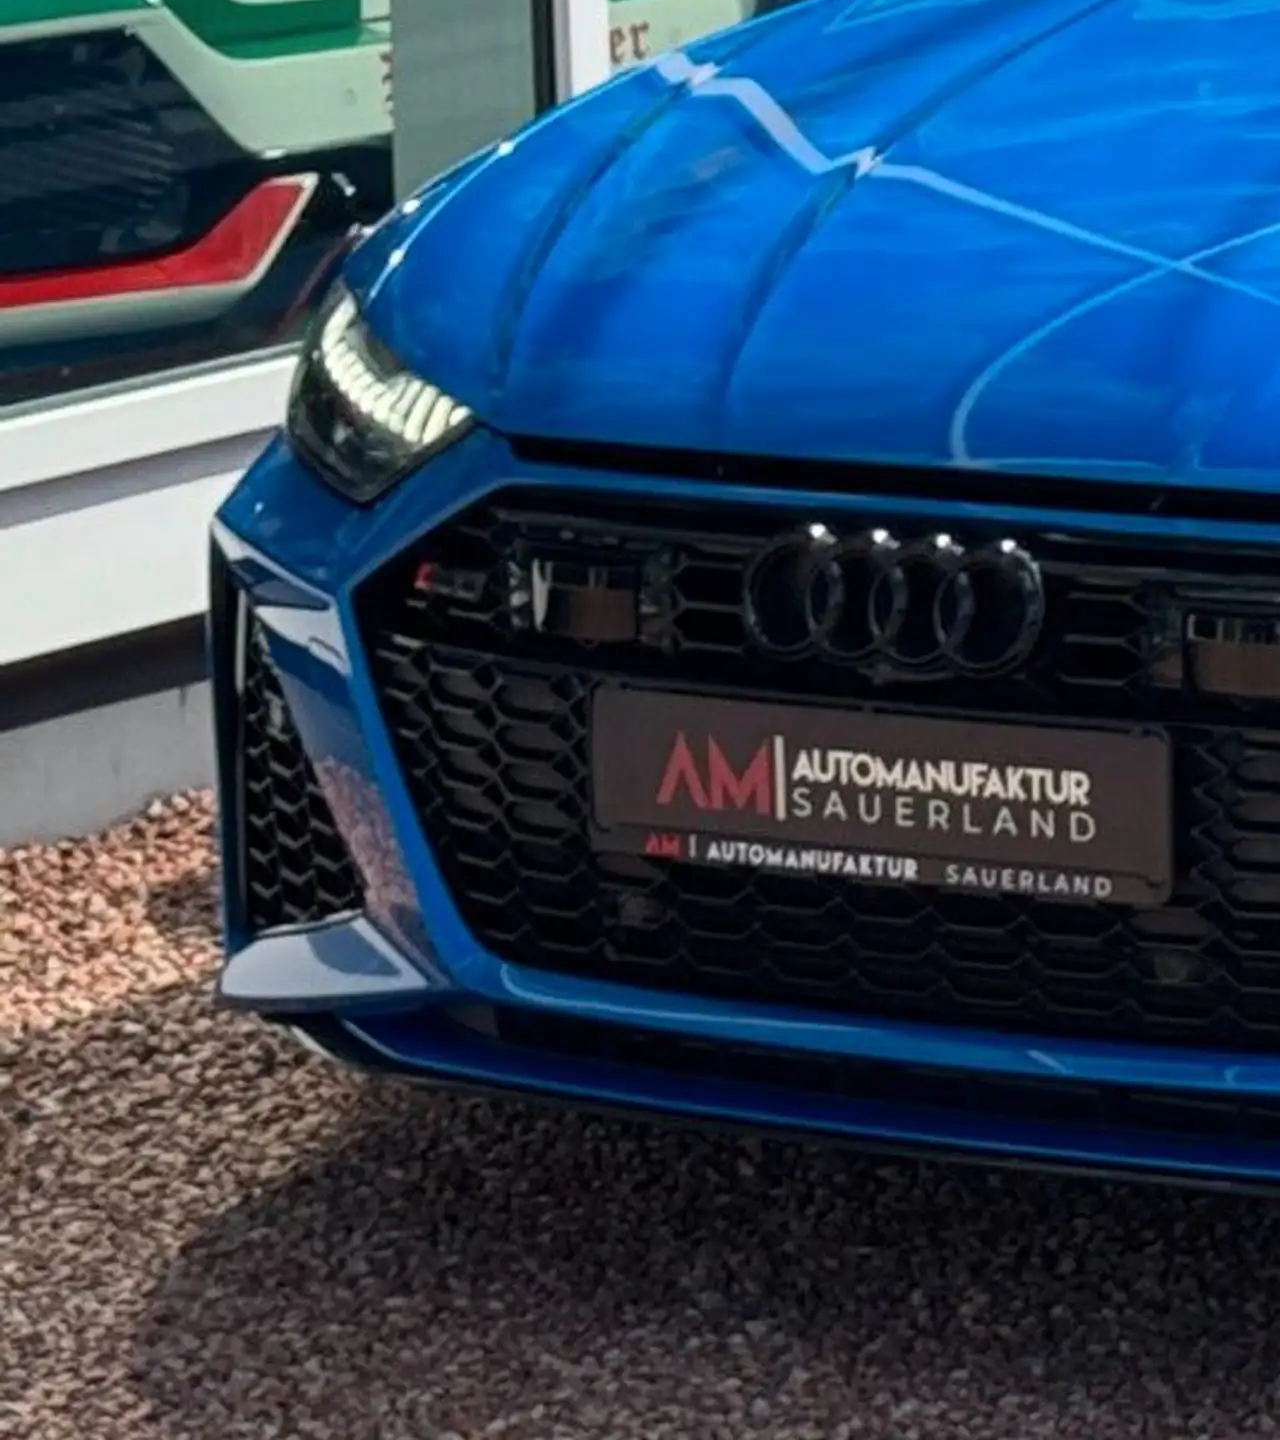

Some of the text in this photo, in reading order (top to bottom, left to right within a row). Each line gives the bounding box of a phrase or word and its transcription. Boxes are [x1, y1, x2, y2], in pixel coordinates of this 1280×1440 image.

[655, 729, 1091, 816] AM AUTOMANUFAKTUR
[791, 787, 1097, 843] SAUERLAND
[706, 840, 919, 881] AUTOMANUFAKTUR
[945, 863, 1113, 898] SAUERLAND
